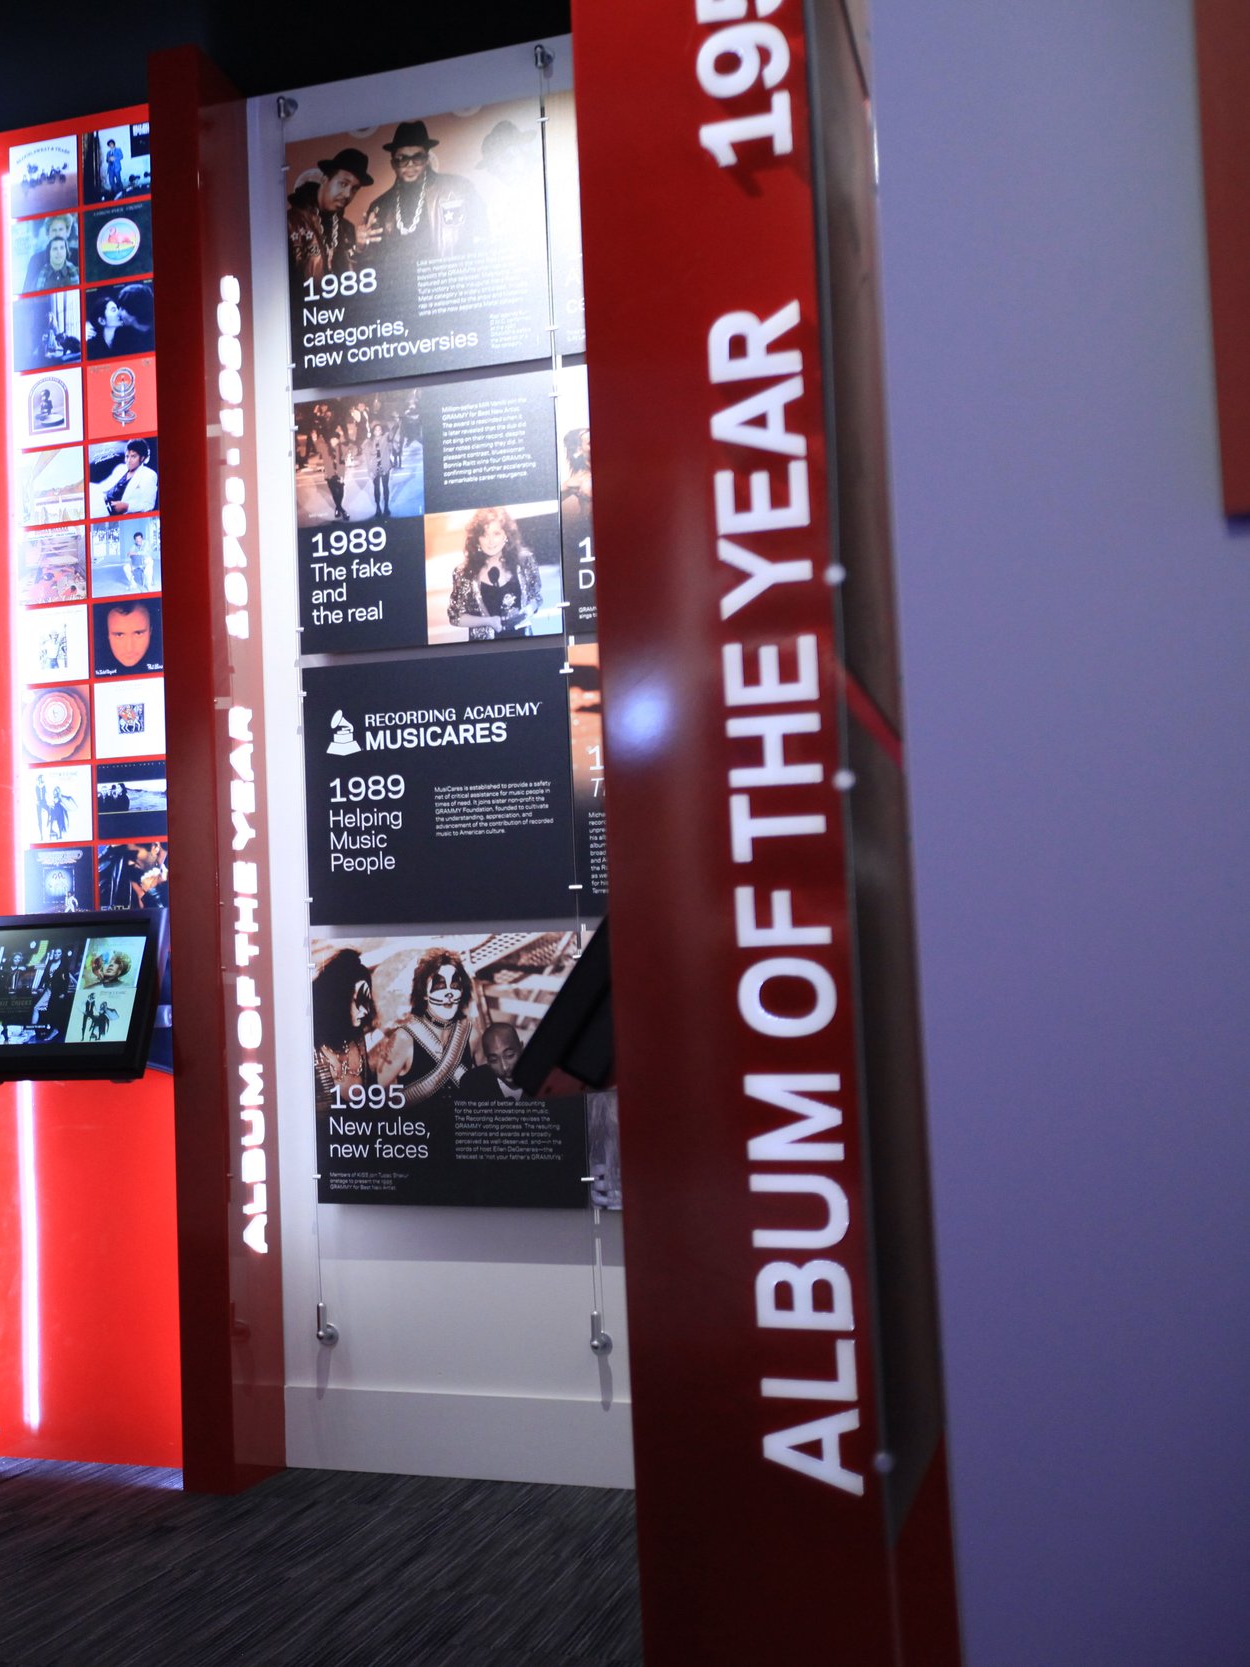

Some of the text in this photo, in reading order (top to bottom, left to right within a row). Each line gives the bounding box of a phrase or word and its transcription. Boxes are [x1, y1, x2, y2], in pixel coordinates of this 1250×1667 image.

[303, 268, 377, 302] 1988
[302, 306, 345, 328] New
[303, 319, 409, 347] categories,
[304, 331, 478, 369] new controversies
[311, 527, 387, 558] 1989
[311, 558, 393, 583] The fake
[312, 583, 348, 604] and
[312, 601, 383, 625] the real
[365, 702, 541, 728] RECORDING ACADEMY
[365, 722, 508, 750] MUSICARES
[695, 0, 864, 1497] ALBUM OF THE YEAR 19
[229, 706, 256, 851] YEAR
[329, 774, 405, 802] 1989
[330, 808, 402, 830] Helping
[330, 831, 388, 850] Music
[330, 852, 396, 874] People
[233, 860, 259, 967] THE
[329, 1084, 406, 1110] 1995
[329, 1116, 430, 1139] New rules,
[240, 1062, 268, 1254] ALBUM
[330, 1138, 429, 1158] new faces
